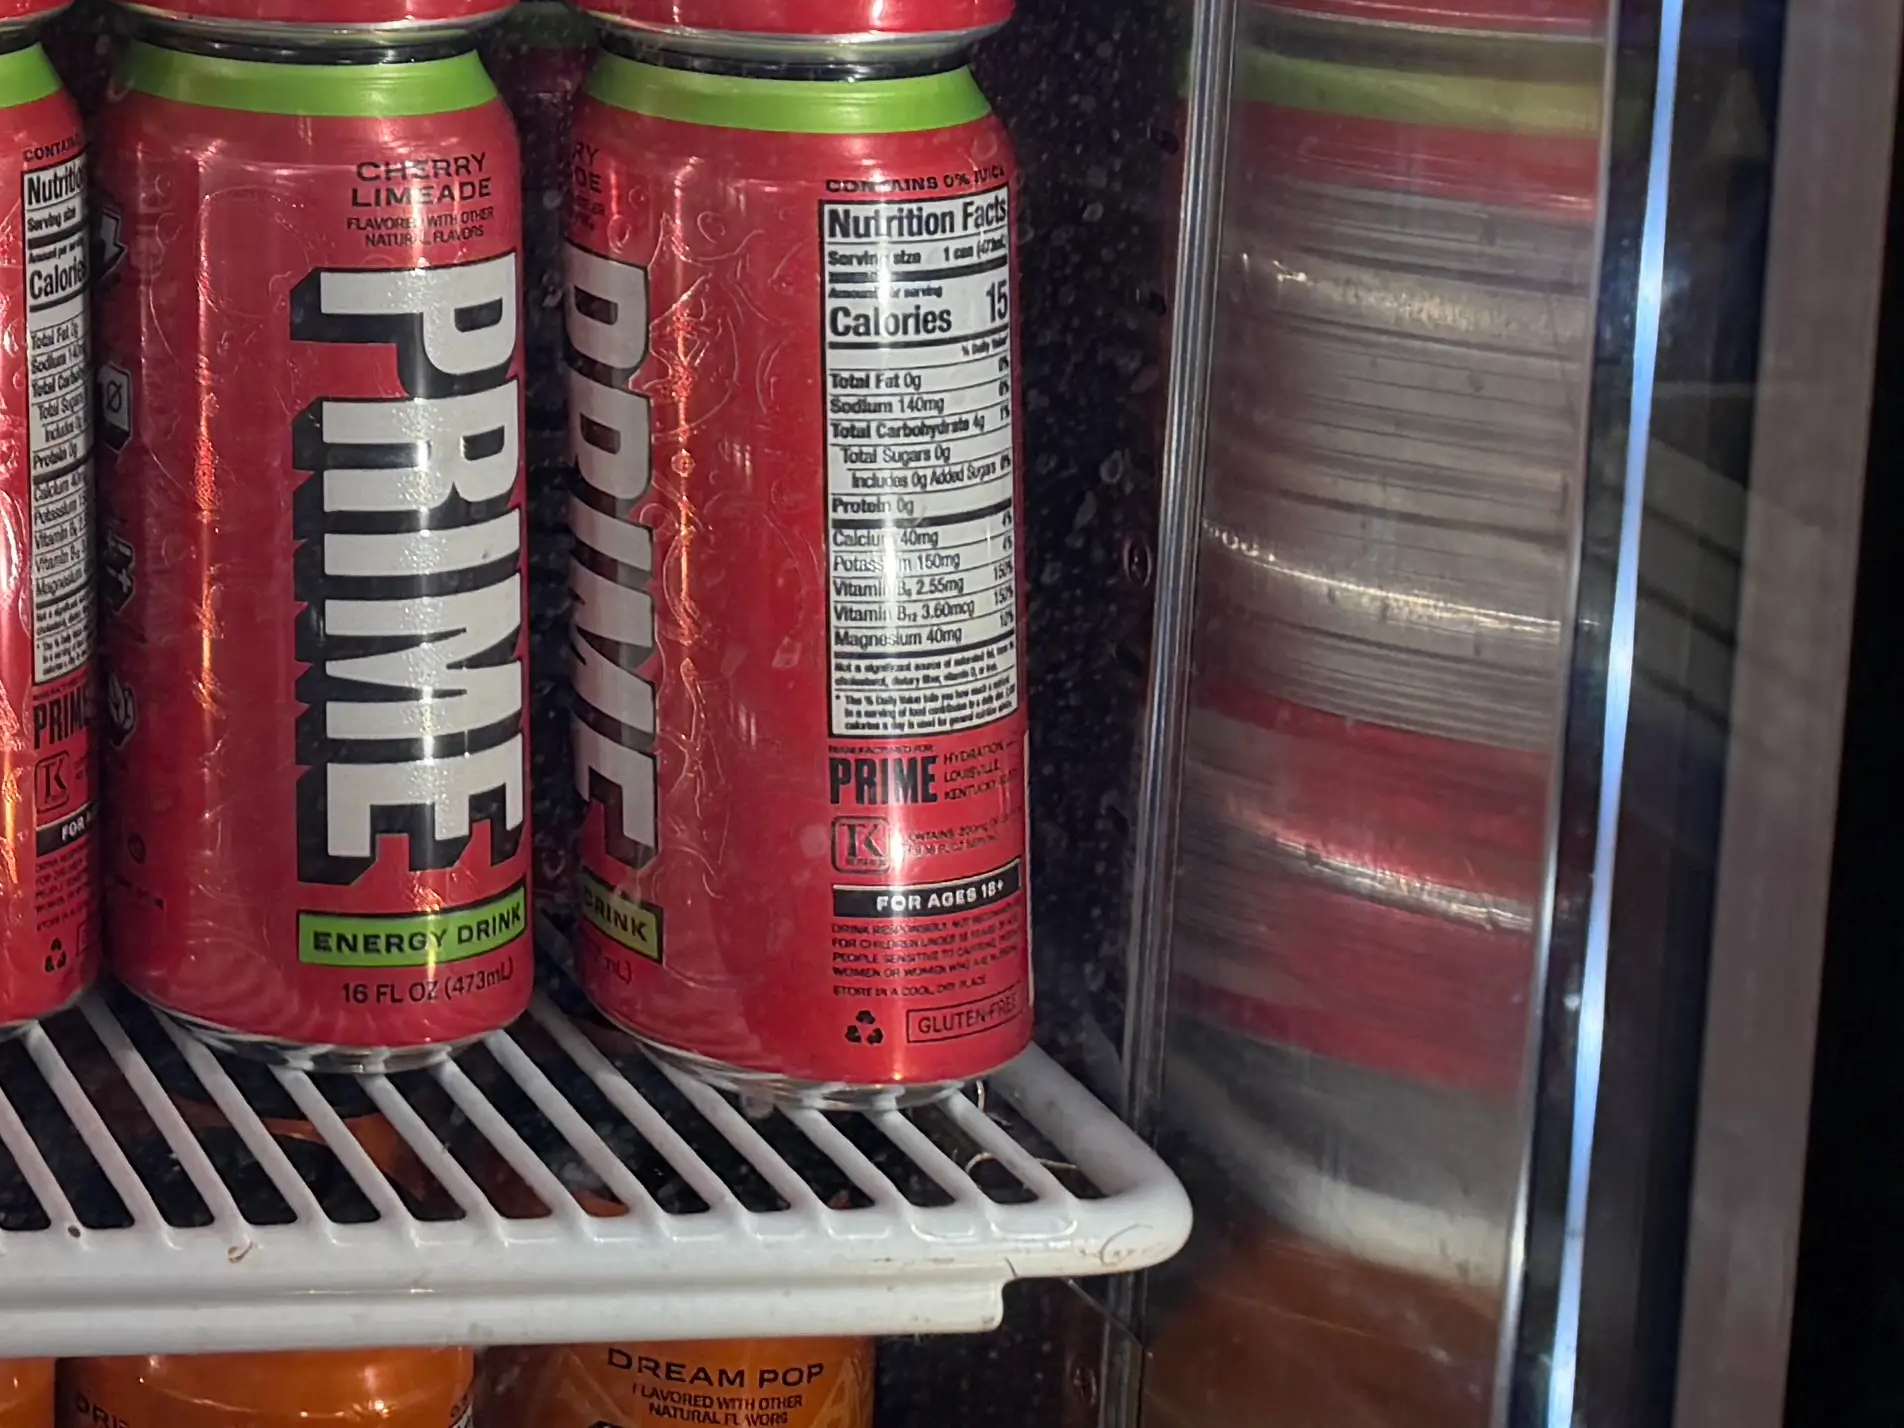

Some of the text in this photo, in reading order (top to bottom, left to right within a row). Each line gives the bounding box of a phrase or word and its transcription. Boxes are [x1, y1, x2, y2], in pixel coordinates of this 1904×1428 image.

[828, 195, 1007, 240] Nutrition Facts
[829, 279, 1008, 337] Calories 15
[830, 372, 922, 391] Total Fat 0g
[830, 396, 945, 416] Sodium 140mg
[830, 421, 872, 439] Total
[875, 417, 970, 440] Carbohydrate
[842, 444, 950, 467] Total Sugars 0g
[831, 496, 914, 515] Protein 0g
[294, 251, 527, 886] PRIME
[833, 627, 963, 650] Magnesium 40mg
[829, 755, 939, 805] PRIME
[876, 893, 922, 912] FOR
[927, 885, 976, 910] AGES
[312, 907, 524, 956] ENERGY DRINK
[917, 996, 1019, 1036] GLUTEN-FREE
[606, 1346, 824, 1388] DREAM POP
[715, 1392, 752, 1410] WITH
[756, 1393, 804, 1411] OTHER
